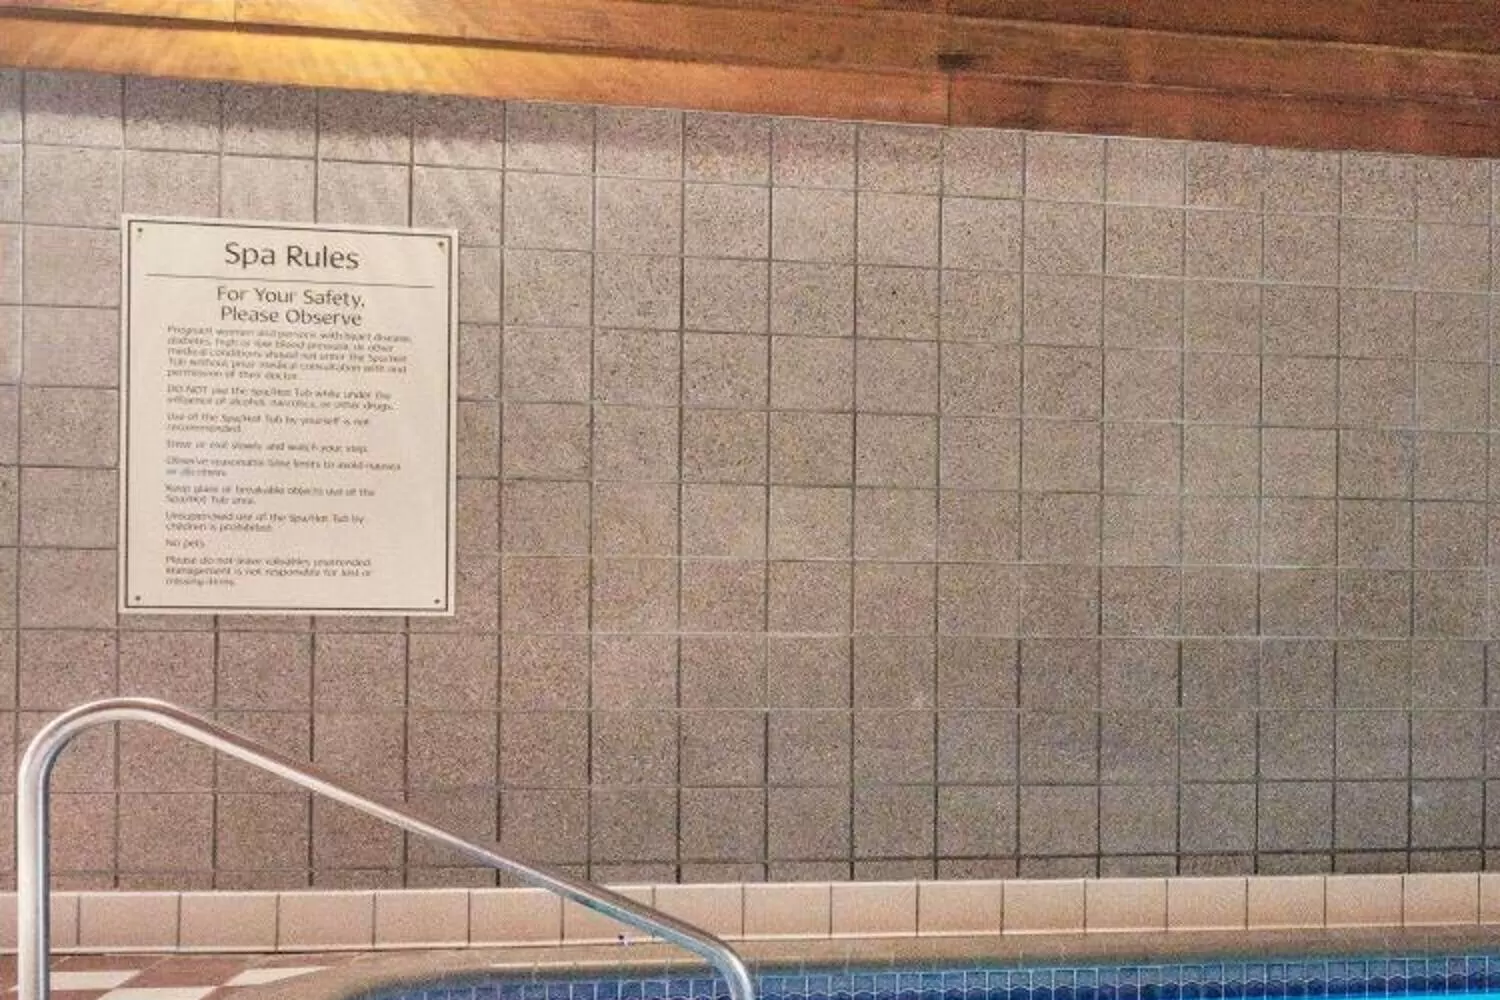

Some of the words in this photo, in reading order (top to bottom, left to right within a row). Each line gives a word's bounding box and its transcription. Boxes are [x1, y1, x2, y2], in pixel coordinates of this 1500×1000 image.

[224, 241, 275, 269] Spa
[286, 245, 360, 270] Rules
[217, 286, 250, 301] For
[252, 288, 294, 303] Your
[303, 290, 365, 308] Safety,
[221, 305, 279, 323] Please
[285, 309, 362, 327] Observe
[165, 539, 181, 547] No
[165, 556, 197, 565] Please
